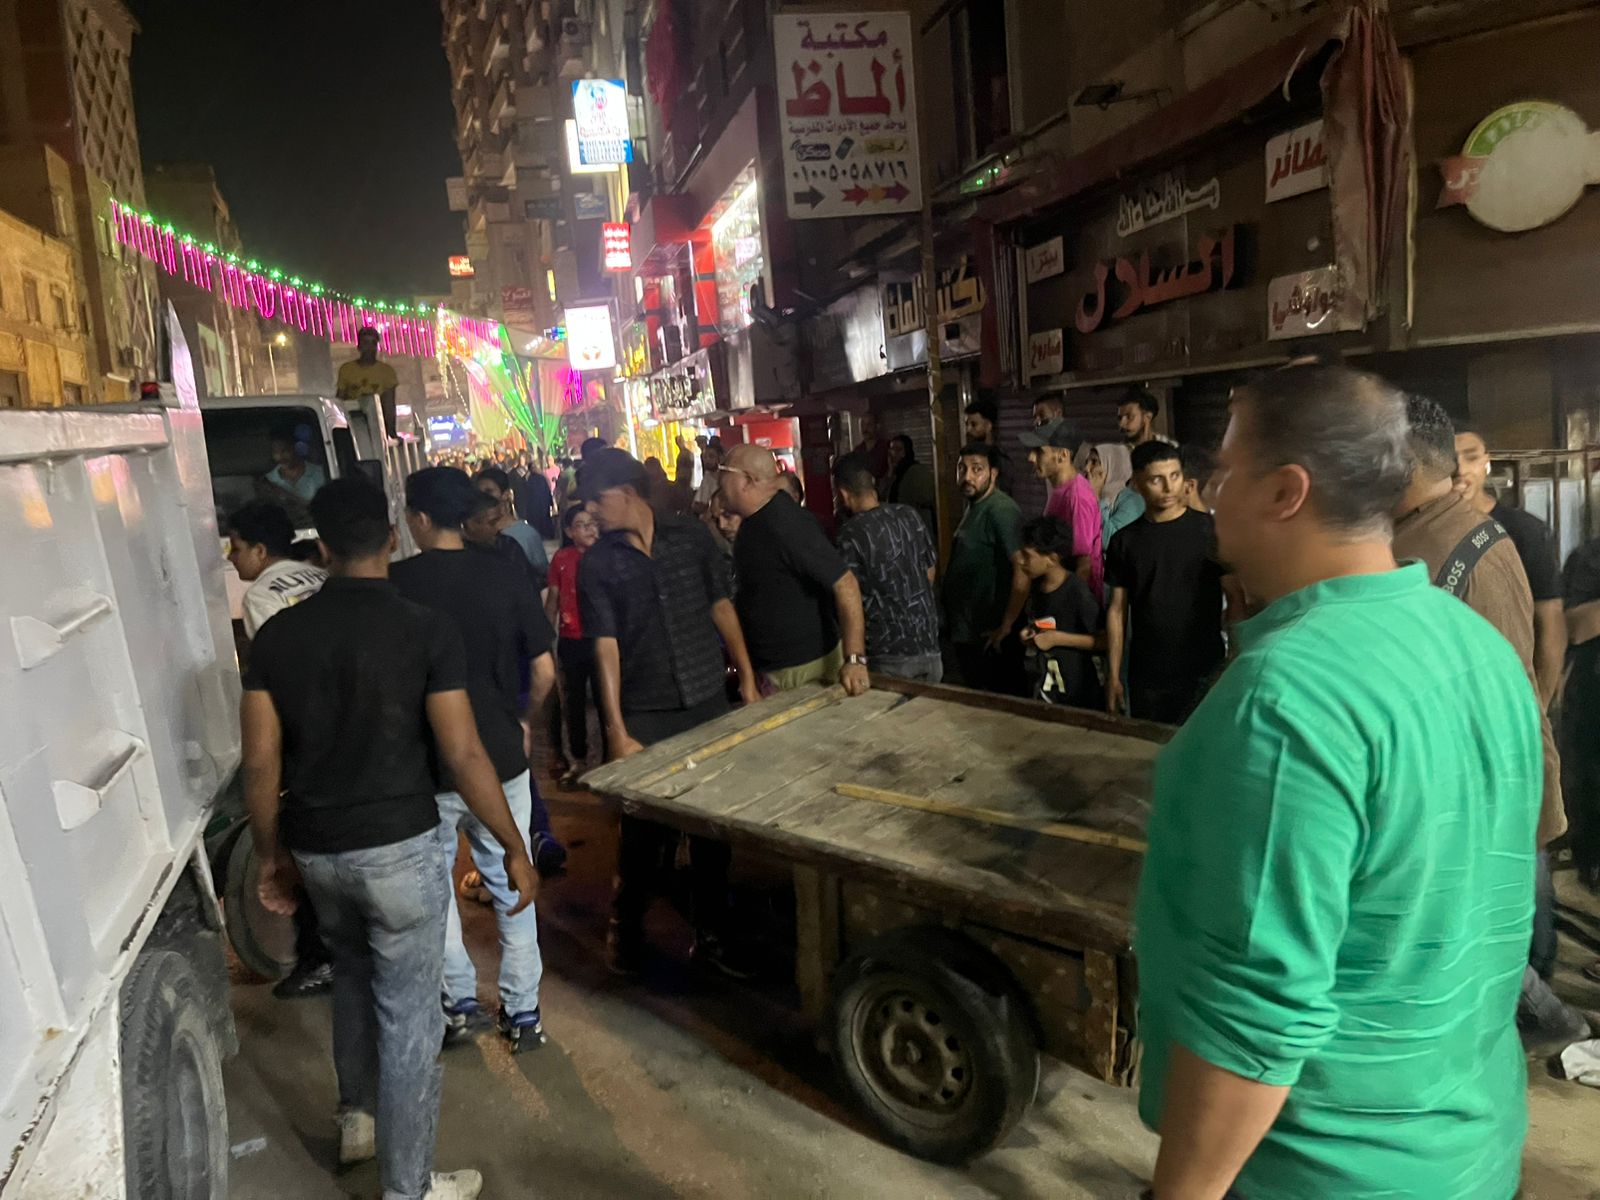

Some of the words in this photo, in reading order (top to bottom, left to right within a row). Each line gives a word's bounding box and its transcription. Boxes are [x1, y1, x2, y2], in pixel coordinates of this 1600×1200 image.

[797, 21, 888, 58] مكتبة
[786, 48, 906, 117] ألماظ
[1471, 529, 1490, 549] BOSS
